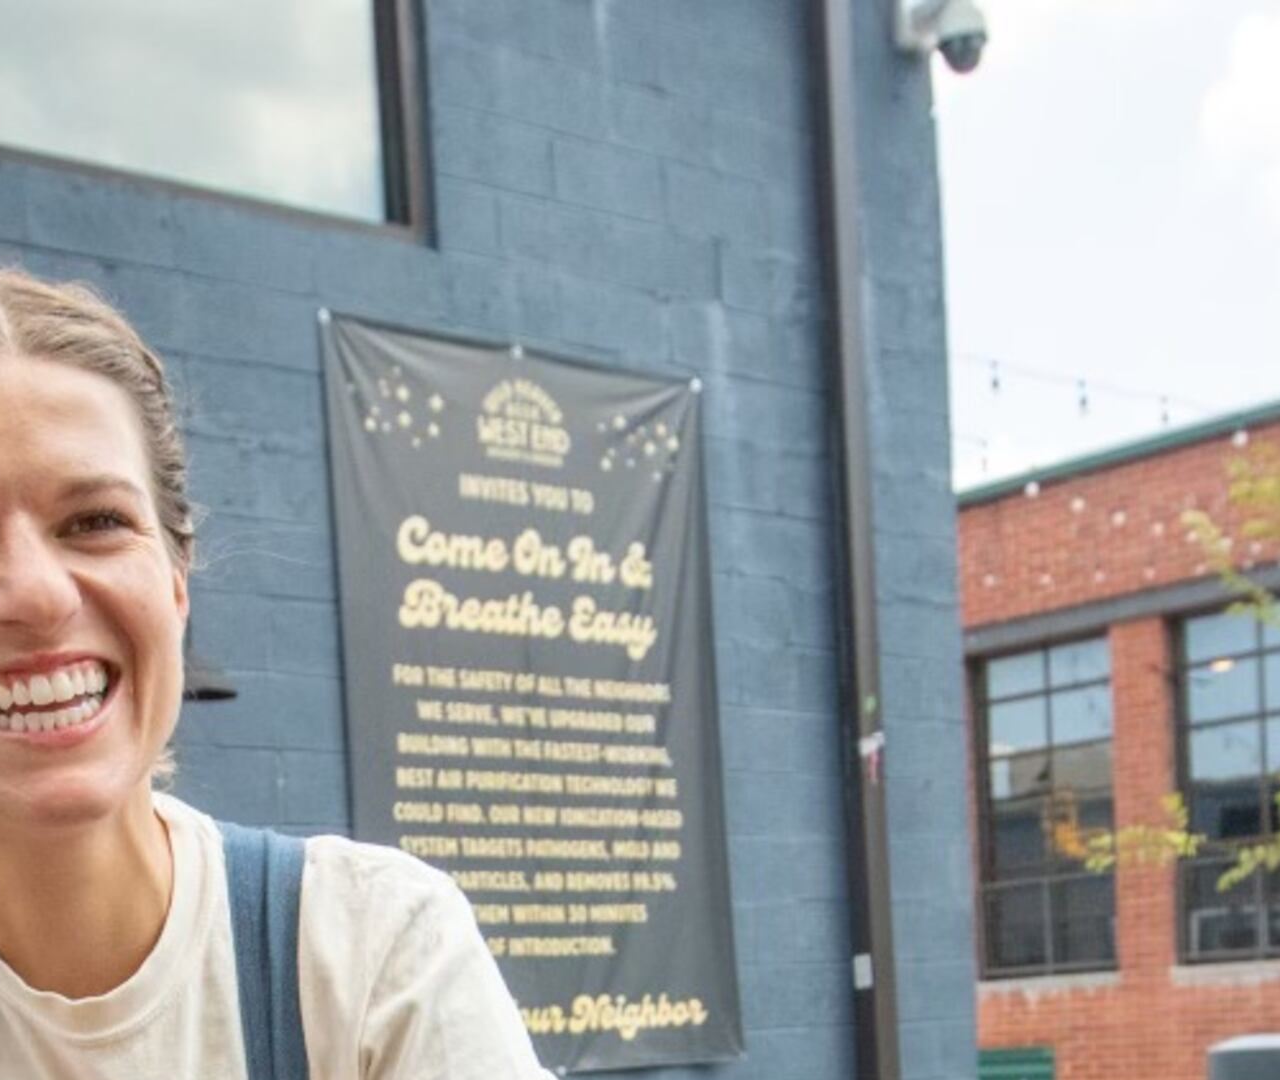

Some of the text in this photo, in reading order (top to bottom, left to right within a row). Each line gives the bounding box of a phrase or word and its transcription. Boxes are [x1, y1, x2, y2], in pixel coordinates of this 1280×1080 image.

[476, 414, 571, 455] WEST END
[458, 472, 594, 515] INVITES YOU TO
[397, 514, 654, 589] Come On In &
[399, 578, 658, 661] Breathe Easy
[392, 663, 423, 685] FOR
[426, 666, 456, 688] THE
[459, 668, 513, 692] SAFETY
[515, 672, 535, 693] OF
[537, 675, 563, 697] ALL
[563, 676, 592, 699] THE
[417, 699, 443, 721] WE
[624, 713, 656, 734] OUR
[396, 767, 678, 798] BEST AIR PURIFICATION TECHNOLOGY WE
[393, 801, 443, 823] COULD
[489, 803, 520, 825] OUR
[523, 805, 557, 827] NEW
[399, 835, 458, 859] SYSTEM
[461, 836, 524, 859] TARGETS
[651, 840, 682, 861] AND
[533, 870, 563, 891] AND
[511, 903, 565, 924] WITHIN
[589, 902, 648, 924] MINUTES
[568, 993, 708, 1040] Neighbor
